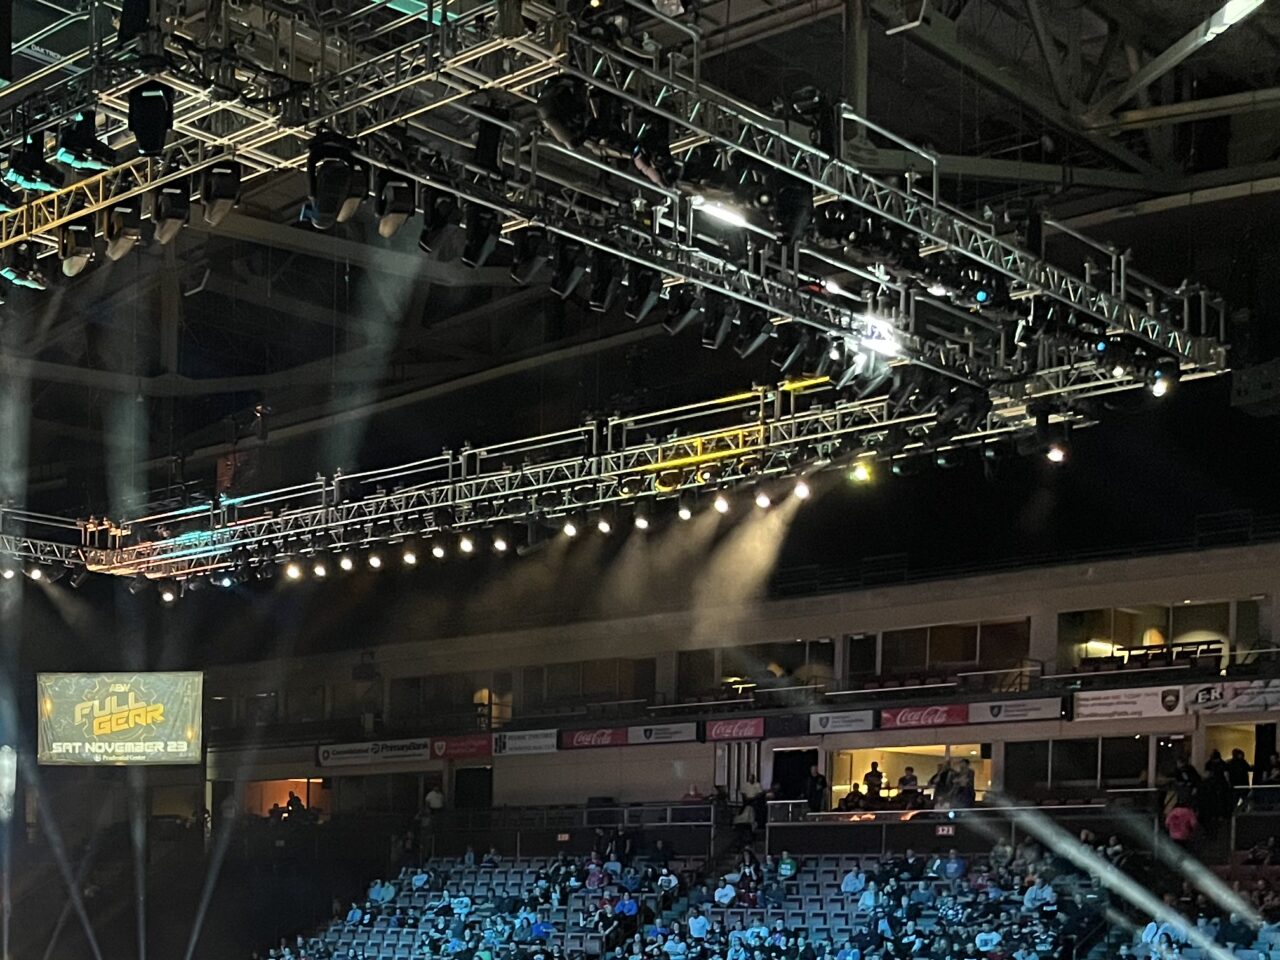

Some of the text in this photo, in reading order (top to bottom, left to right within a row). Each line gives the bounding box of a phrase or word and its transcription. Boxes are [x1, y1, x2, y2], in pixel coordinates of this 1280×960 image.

[74, 691, 147, 726] FULL
[92, 703, 166, 736] GEAR
[52, 741, 188, 753] SAT NOVEMBER 23
